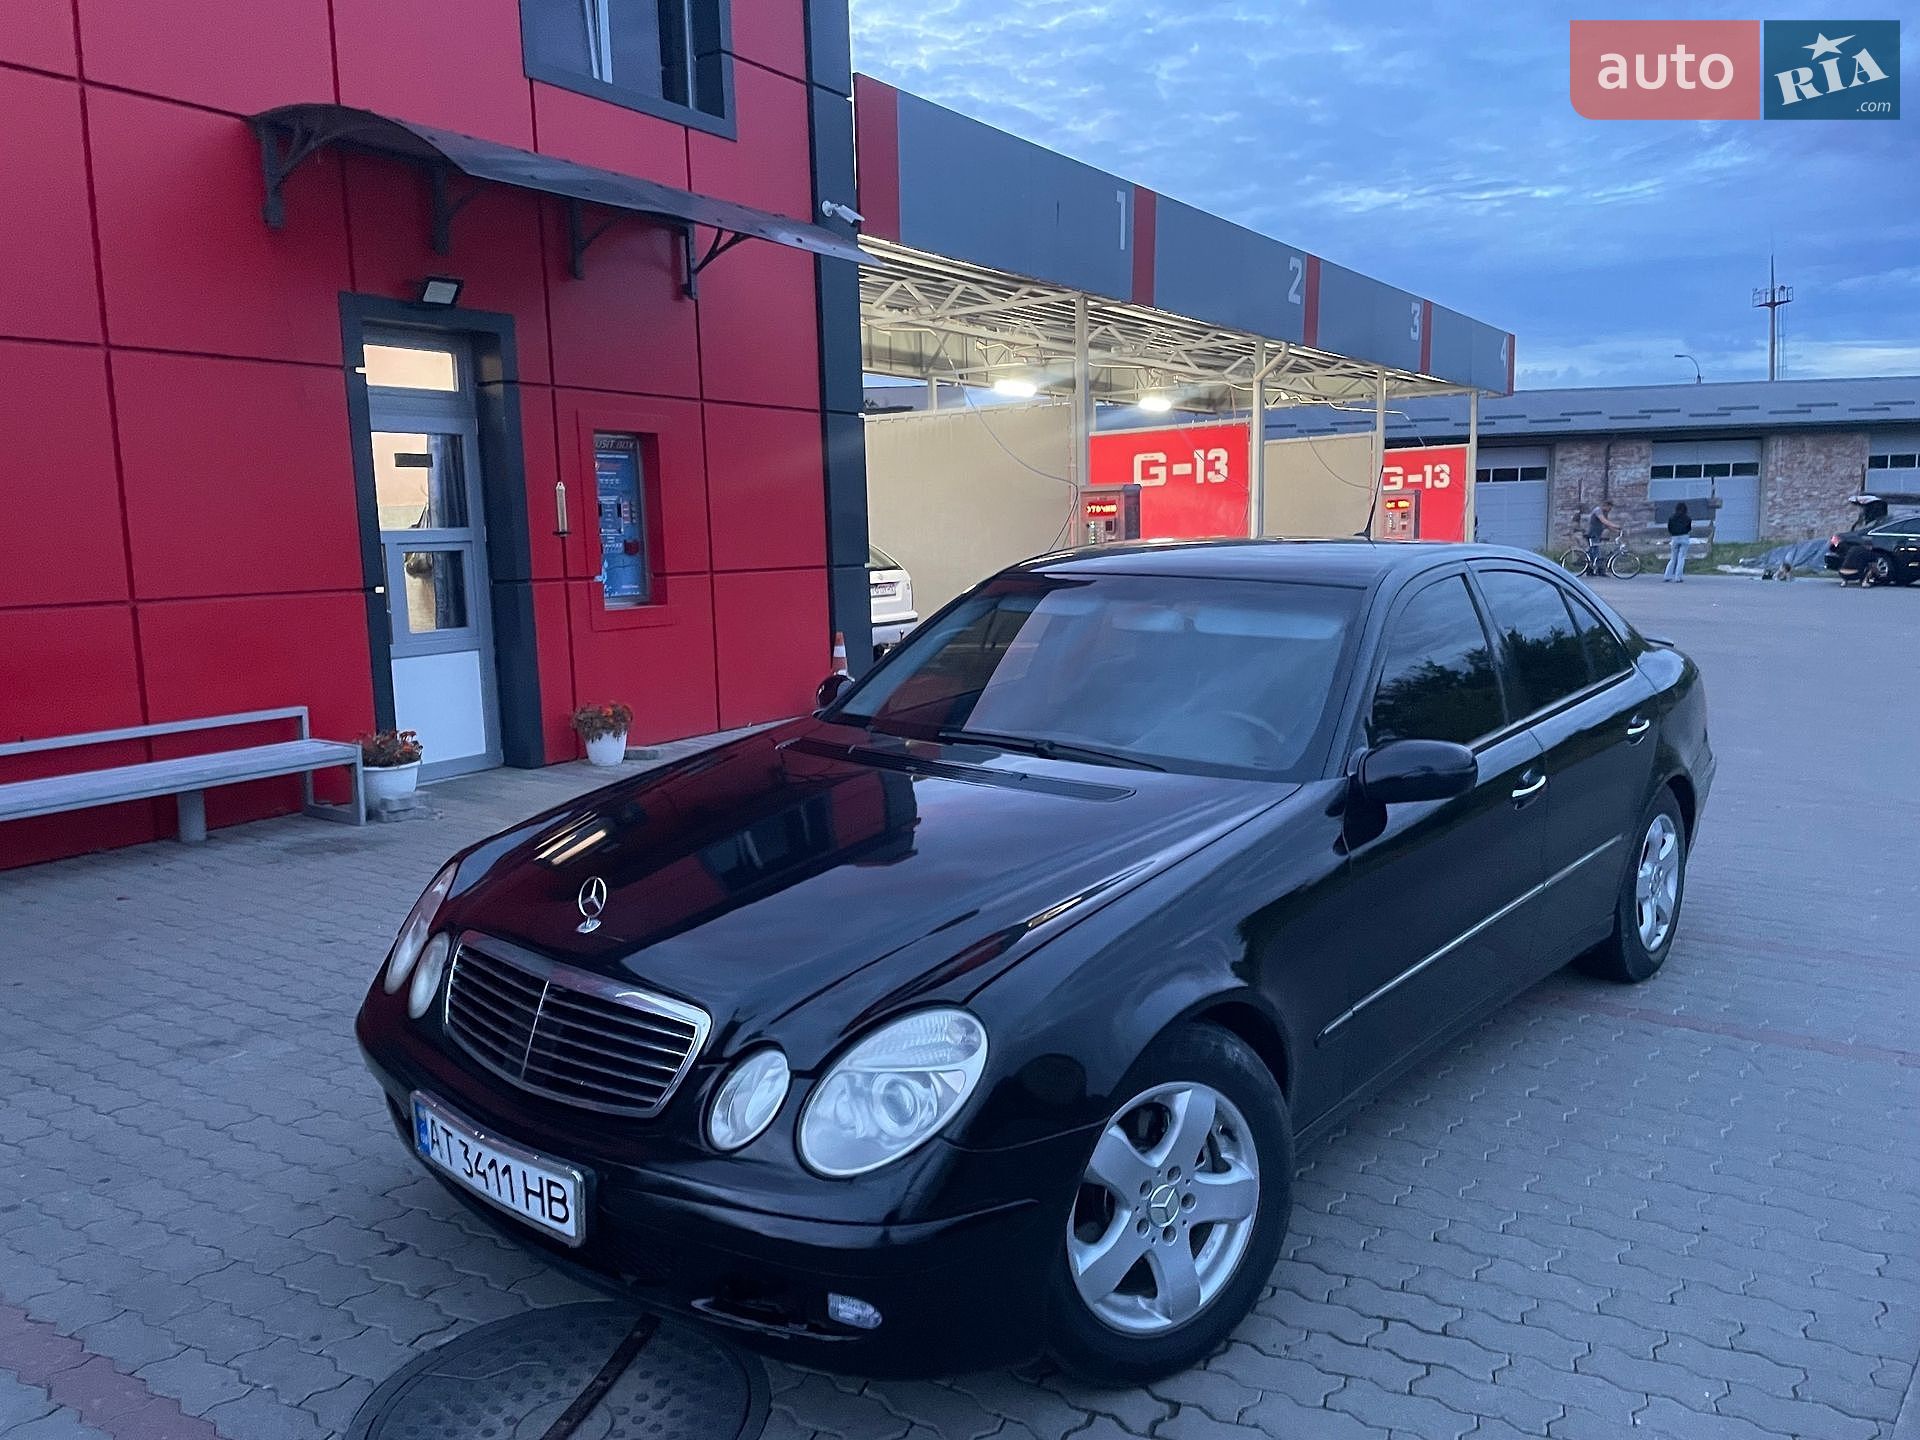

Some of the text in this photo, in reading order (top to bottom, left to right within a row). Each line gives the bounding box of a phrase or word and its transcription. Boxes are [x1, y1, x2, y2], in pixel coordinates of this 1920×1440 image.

[1116, 190, 1126, 251] 1
[1288, 256, 1303, 305] 2
[1410, 302, 1421, 342] 3
[1500, 336, 1507, 368] 4
[1133, 447, 1229, 488] G-13
[1383, 463, 1451, 491] G-13
[430, 1119, 453, 1166] AT
[458, 1139, 515, 1203] 3411
[521, 1170, 570, 1224] HB
